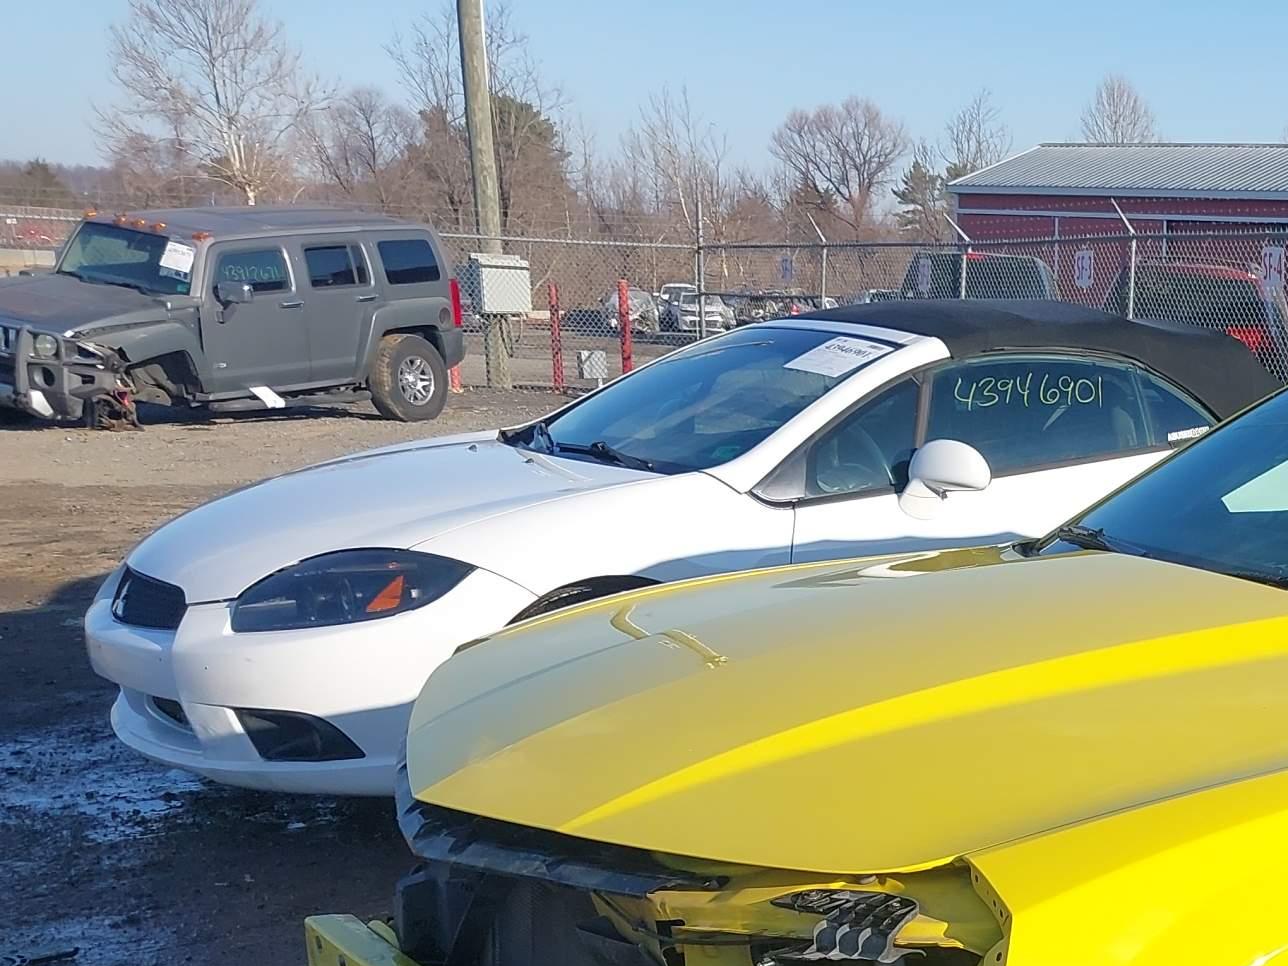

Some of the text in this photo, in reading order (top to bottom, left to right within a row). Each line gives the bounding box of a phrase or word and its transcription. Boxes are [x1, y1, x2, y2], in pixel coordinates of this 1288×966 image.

[1076, 255, 1092, 281] SF-3
[1263, 252, 1282, 281] SF-4
[953, 371, 1103, 411] 43946901
